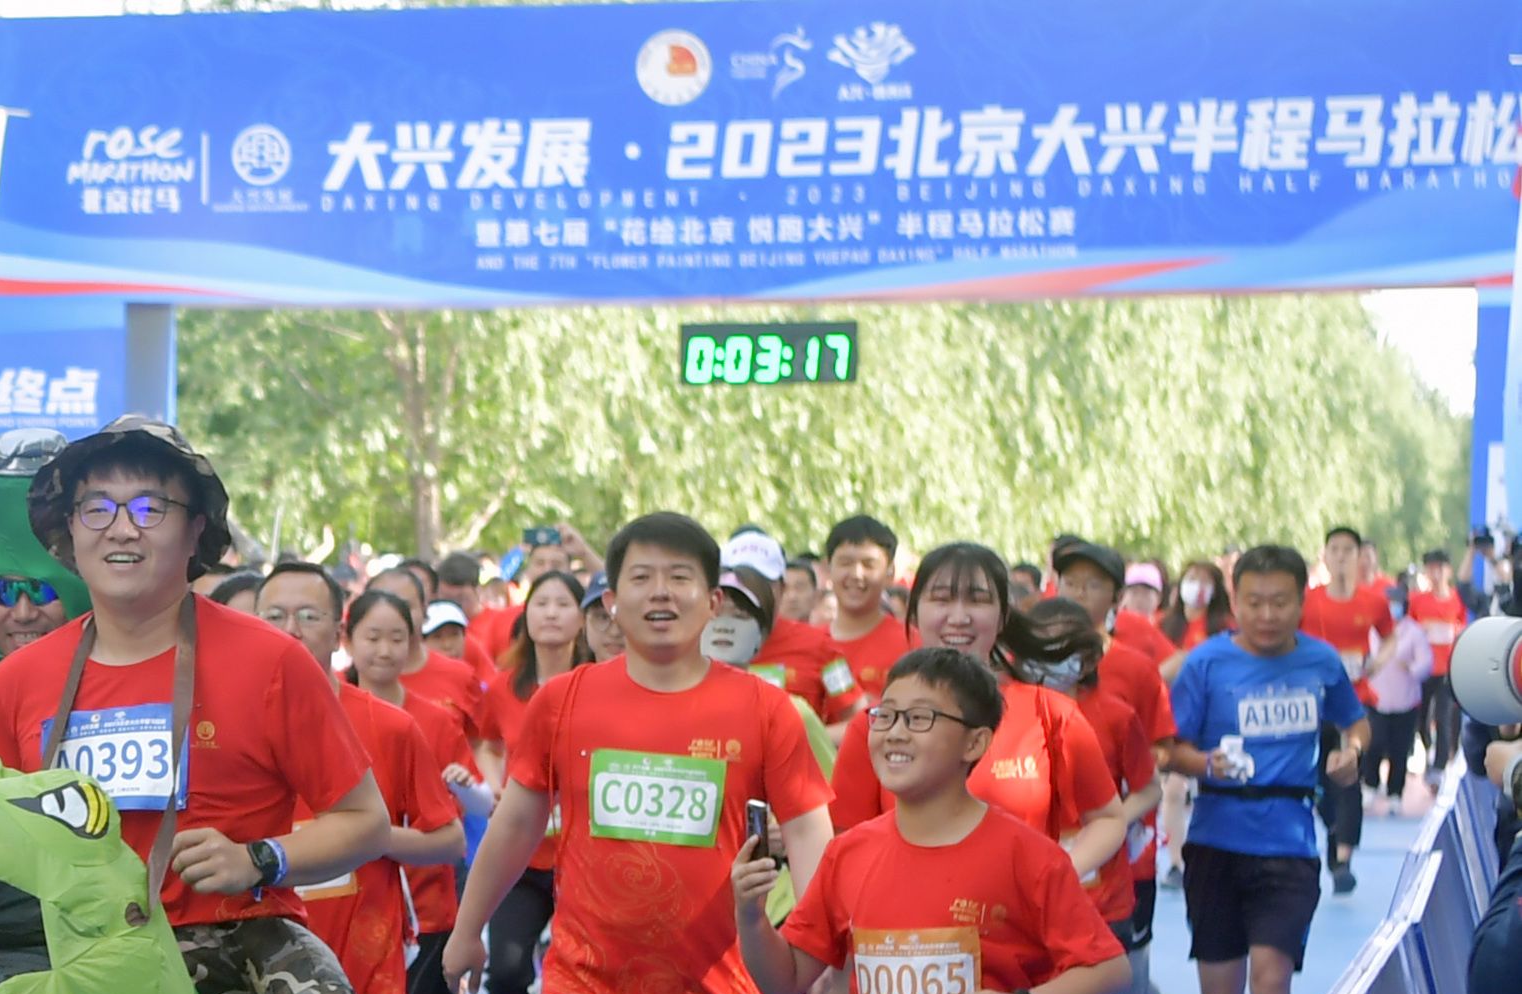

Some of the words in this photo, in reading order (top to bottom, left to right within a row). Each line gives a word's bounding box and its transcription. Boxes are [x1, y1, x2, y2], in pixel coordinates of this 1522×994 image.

[323, 119, 592, 192] 大兴发展
[665, 90, 1522, 180] 2023北京大兴半程马拉松
[321, 194, 441, 212] DAXING
[469, 187, 700, 212] DEVELOPMENT
[786, 185, 866, 206] 2023
[896, 179, 1046, 203] BEIJING
[1079, 172, 1207, 197] DAXING
[1239, 171, 1322, 193] HALF
[685, 334, 851, 384] 0:03:17
[1244, 700, 1310, 727] A1901
[601, 779, 707, 822] C0328
